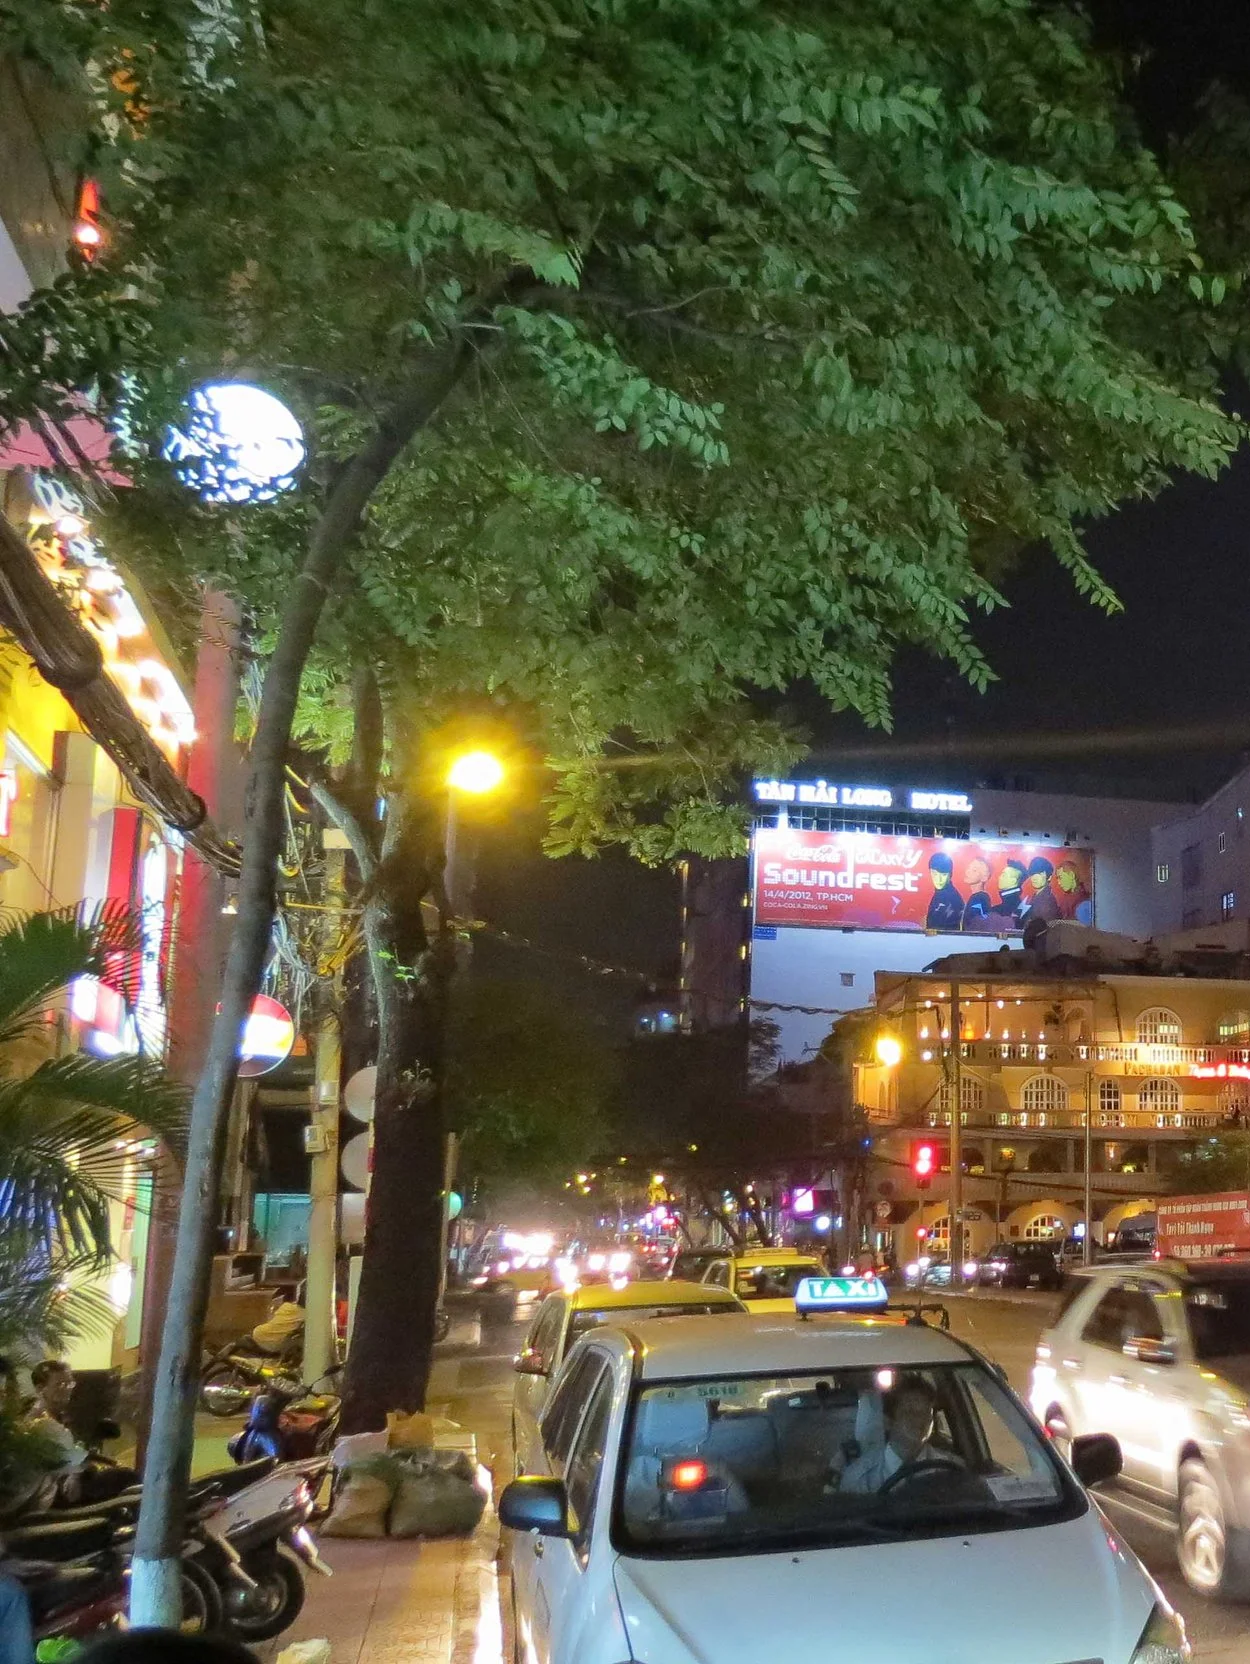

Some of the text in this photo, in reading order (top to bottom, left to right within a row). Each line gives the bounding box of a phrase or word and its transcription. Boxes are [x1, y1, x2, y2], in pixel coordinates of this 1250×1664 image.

[911, 791, 973, 812] HOTEL
[763, 859, 919, 893] Soundfest
[809, 1280, 877, 1298] TAXI
